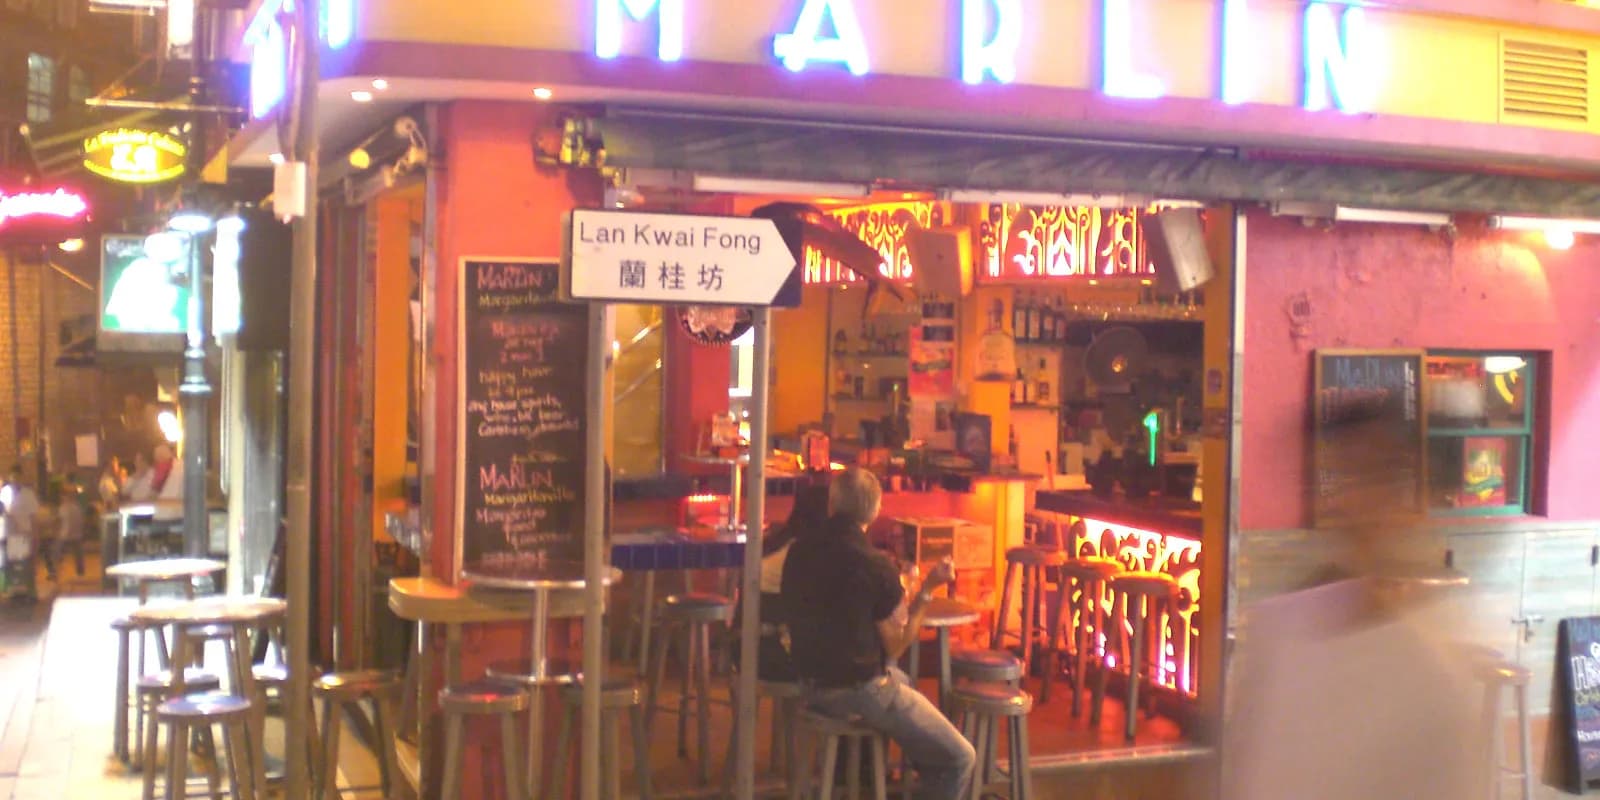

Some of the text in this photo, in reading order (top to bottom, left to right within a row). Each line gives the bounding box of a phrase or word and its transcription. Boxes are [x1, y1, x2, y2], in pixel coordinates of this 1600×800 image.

[595, 0, 1366, 114] MARLIN
[580, 221, 761, 255] Lan Kwai Fong
[619, 259, 724, 292] 蘭桂坊
